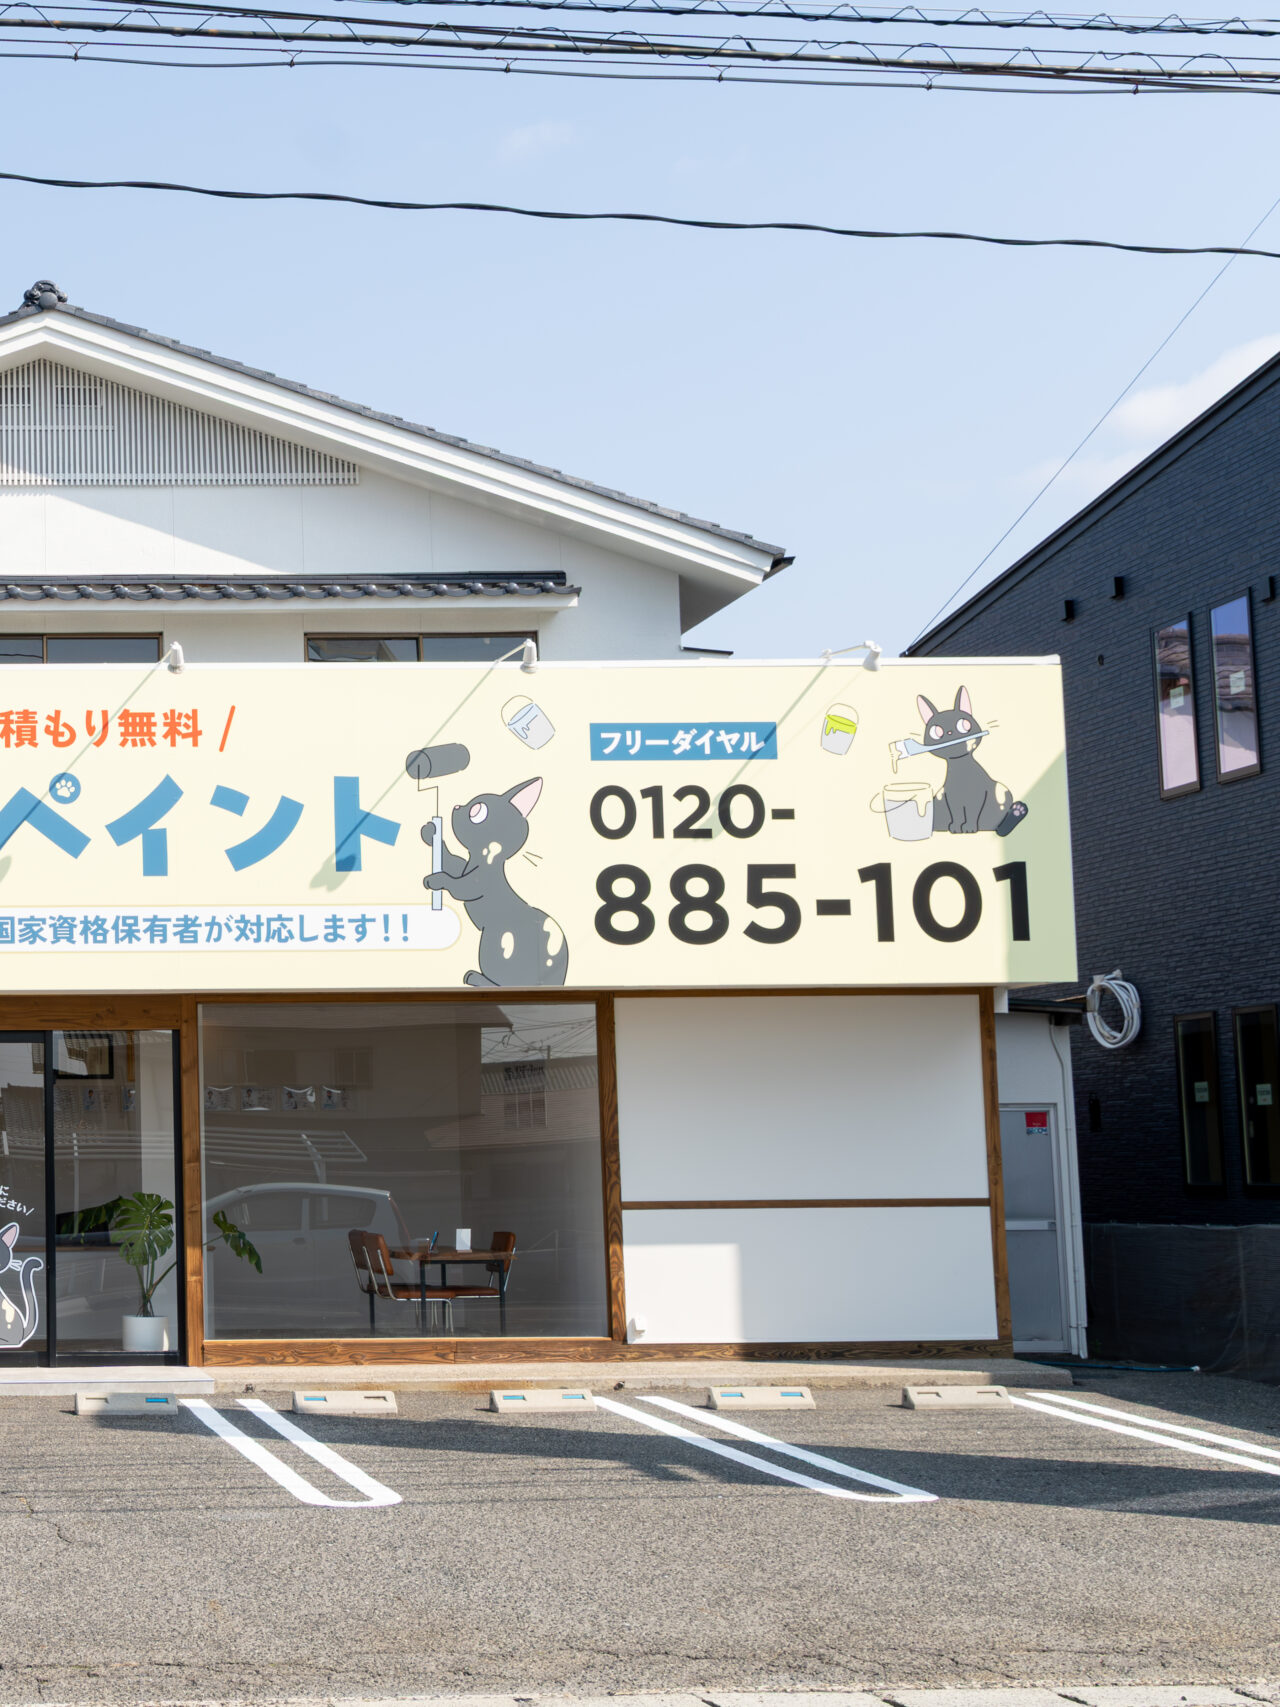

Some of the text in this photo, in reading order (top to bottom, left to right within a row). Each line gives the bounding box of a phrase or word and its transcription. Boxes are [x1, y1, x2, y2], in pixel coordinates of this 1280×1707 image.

[600, 729, 765, 755] フリーダイヤル
[590, 785, 795, 839] 0120-
[594, 861, 1031, 945] 885-101
